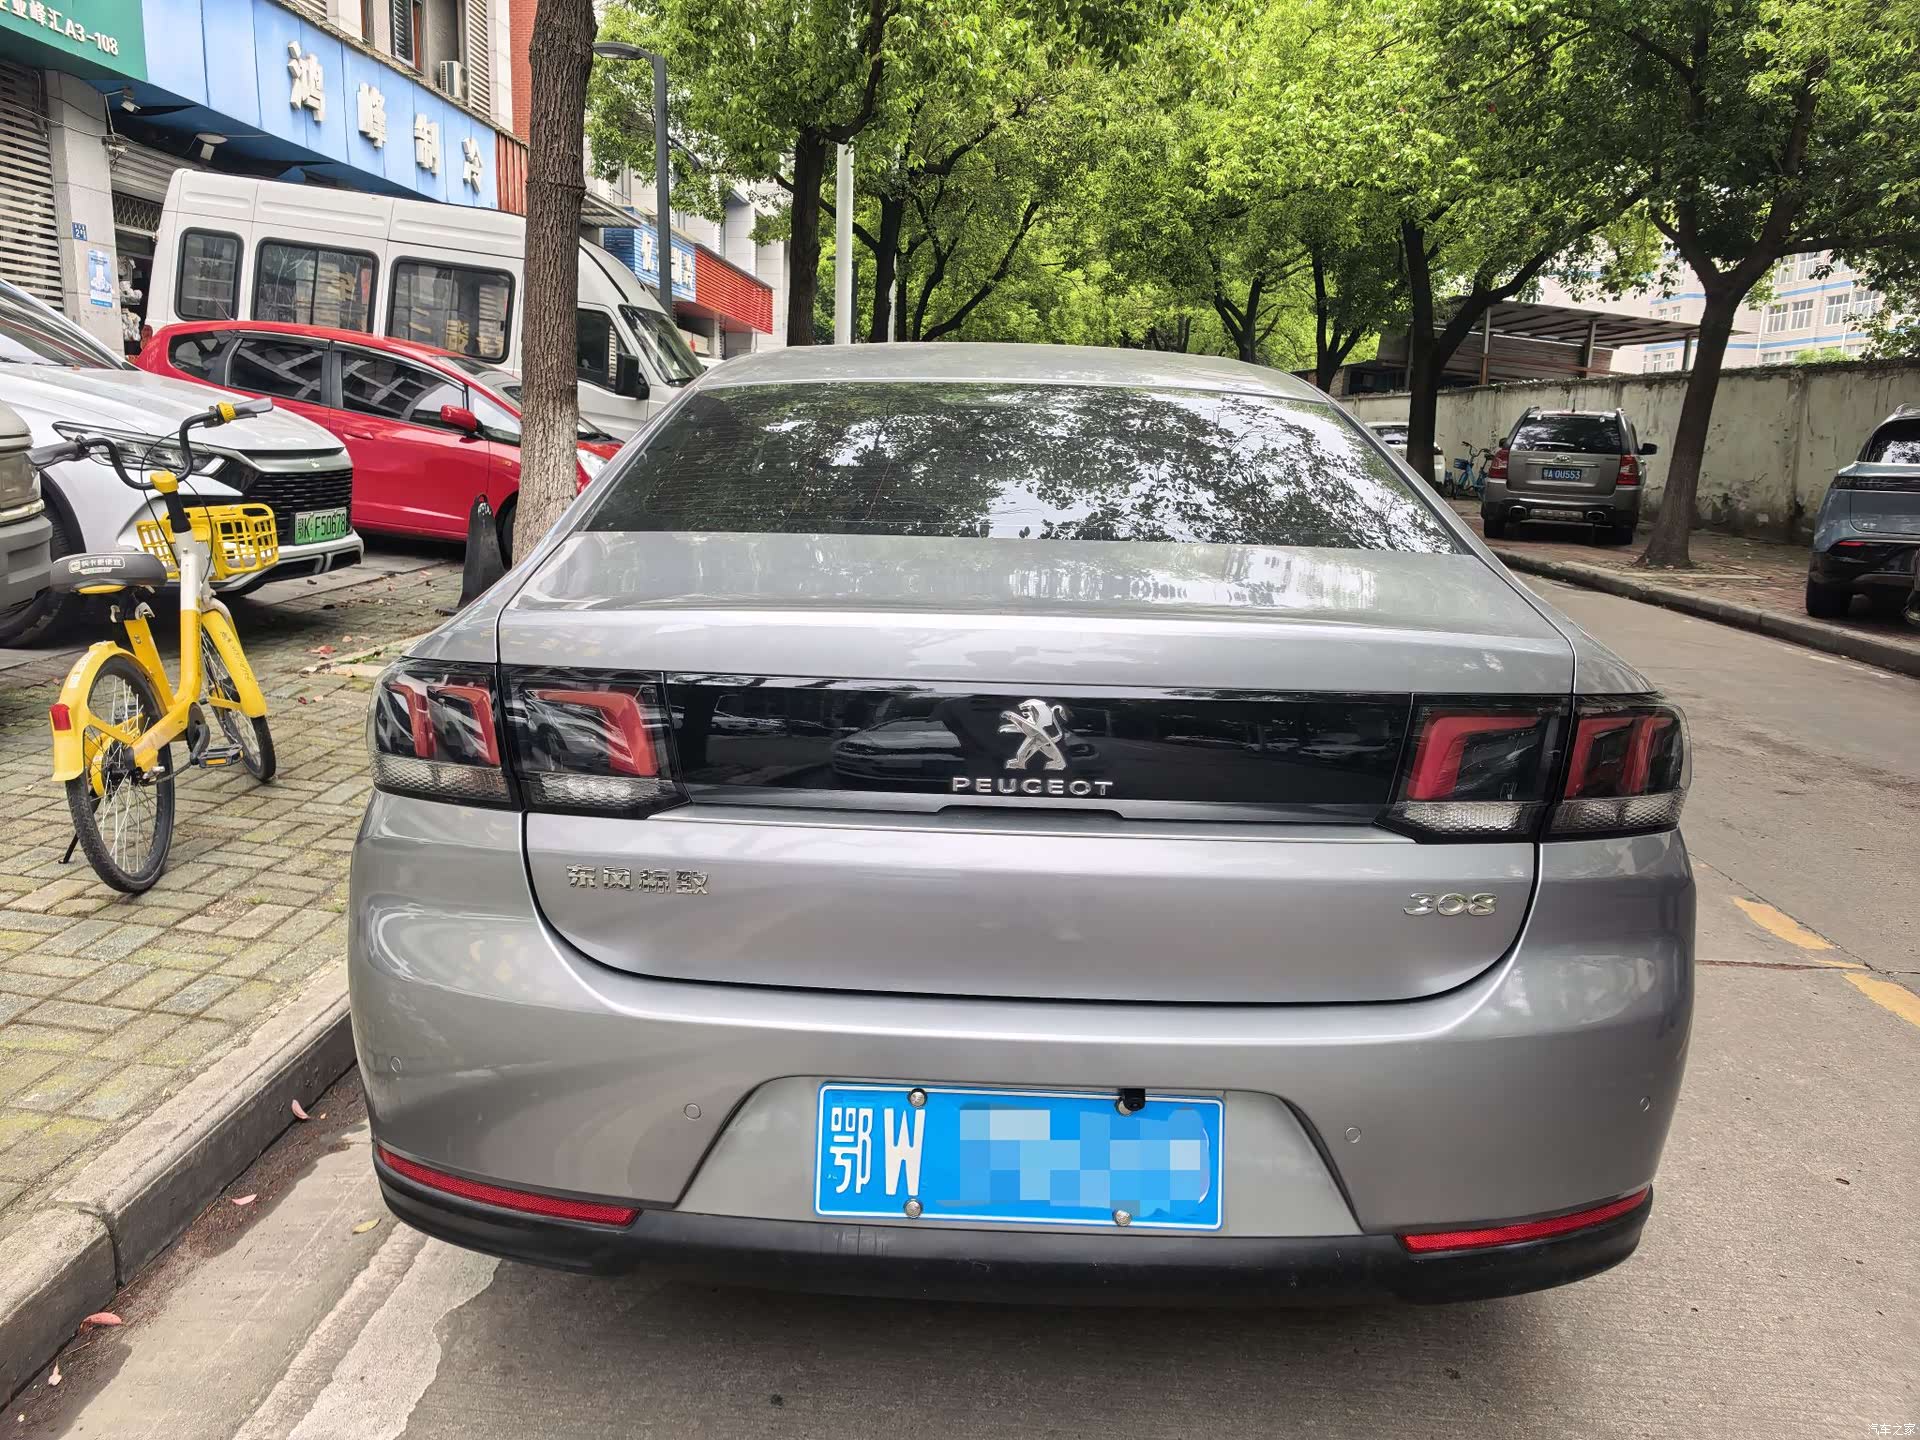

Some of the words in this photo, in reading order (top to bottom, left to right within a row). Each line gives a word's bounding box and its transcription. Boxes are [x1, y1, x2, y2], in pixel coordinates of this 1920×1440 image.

[952, 777, 1113, 796] PEUGEOT
[566, 863, 708, 895] 东风标致
[1403, 892, 1497, 916] 308
